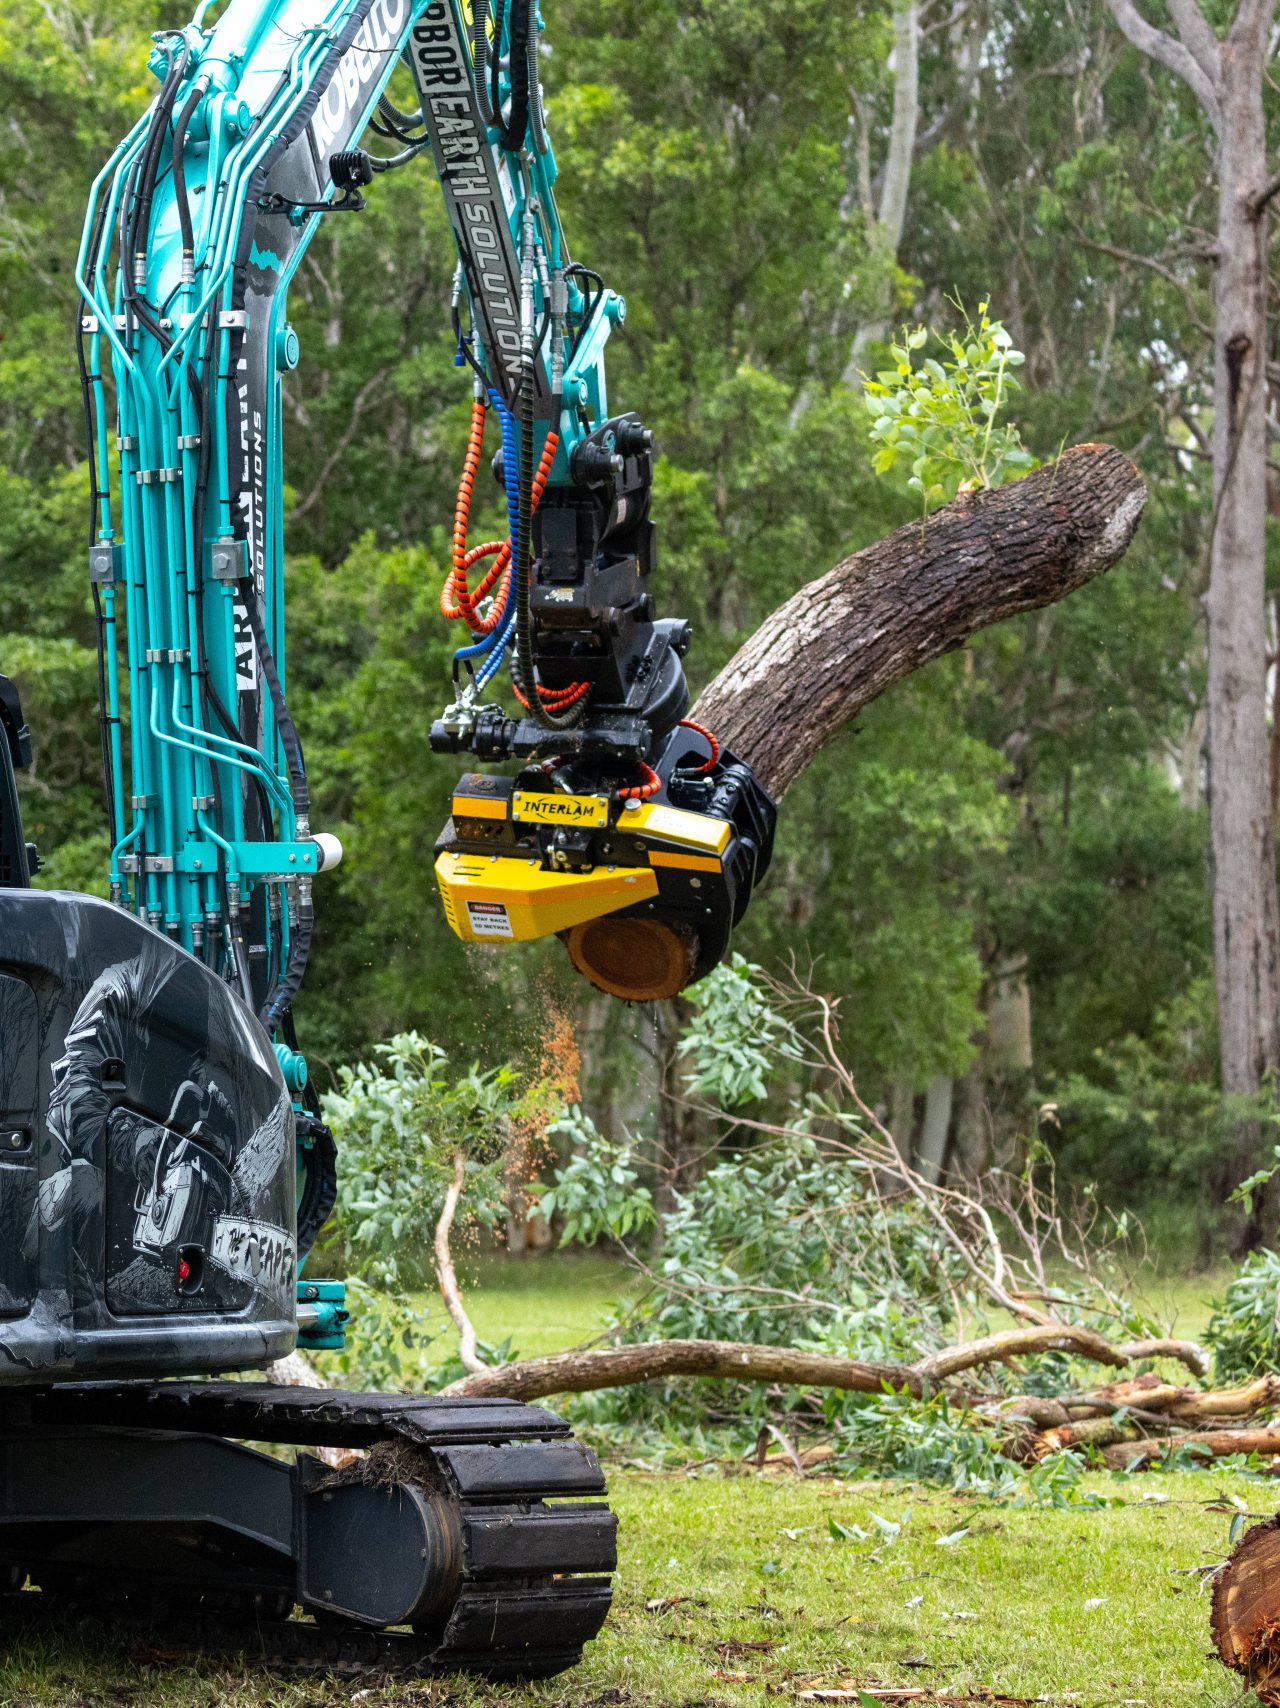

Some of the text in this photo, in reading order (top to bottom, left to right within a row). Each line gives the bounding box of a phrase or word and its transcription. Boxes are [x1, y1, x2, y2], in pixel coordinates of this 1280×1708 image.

[429, 97, 492, 196] EARTH
[253, 411, 265, 593] SOLUTIONS
[523, 801, 595, 817] INTERLAM
